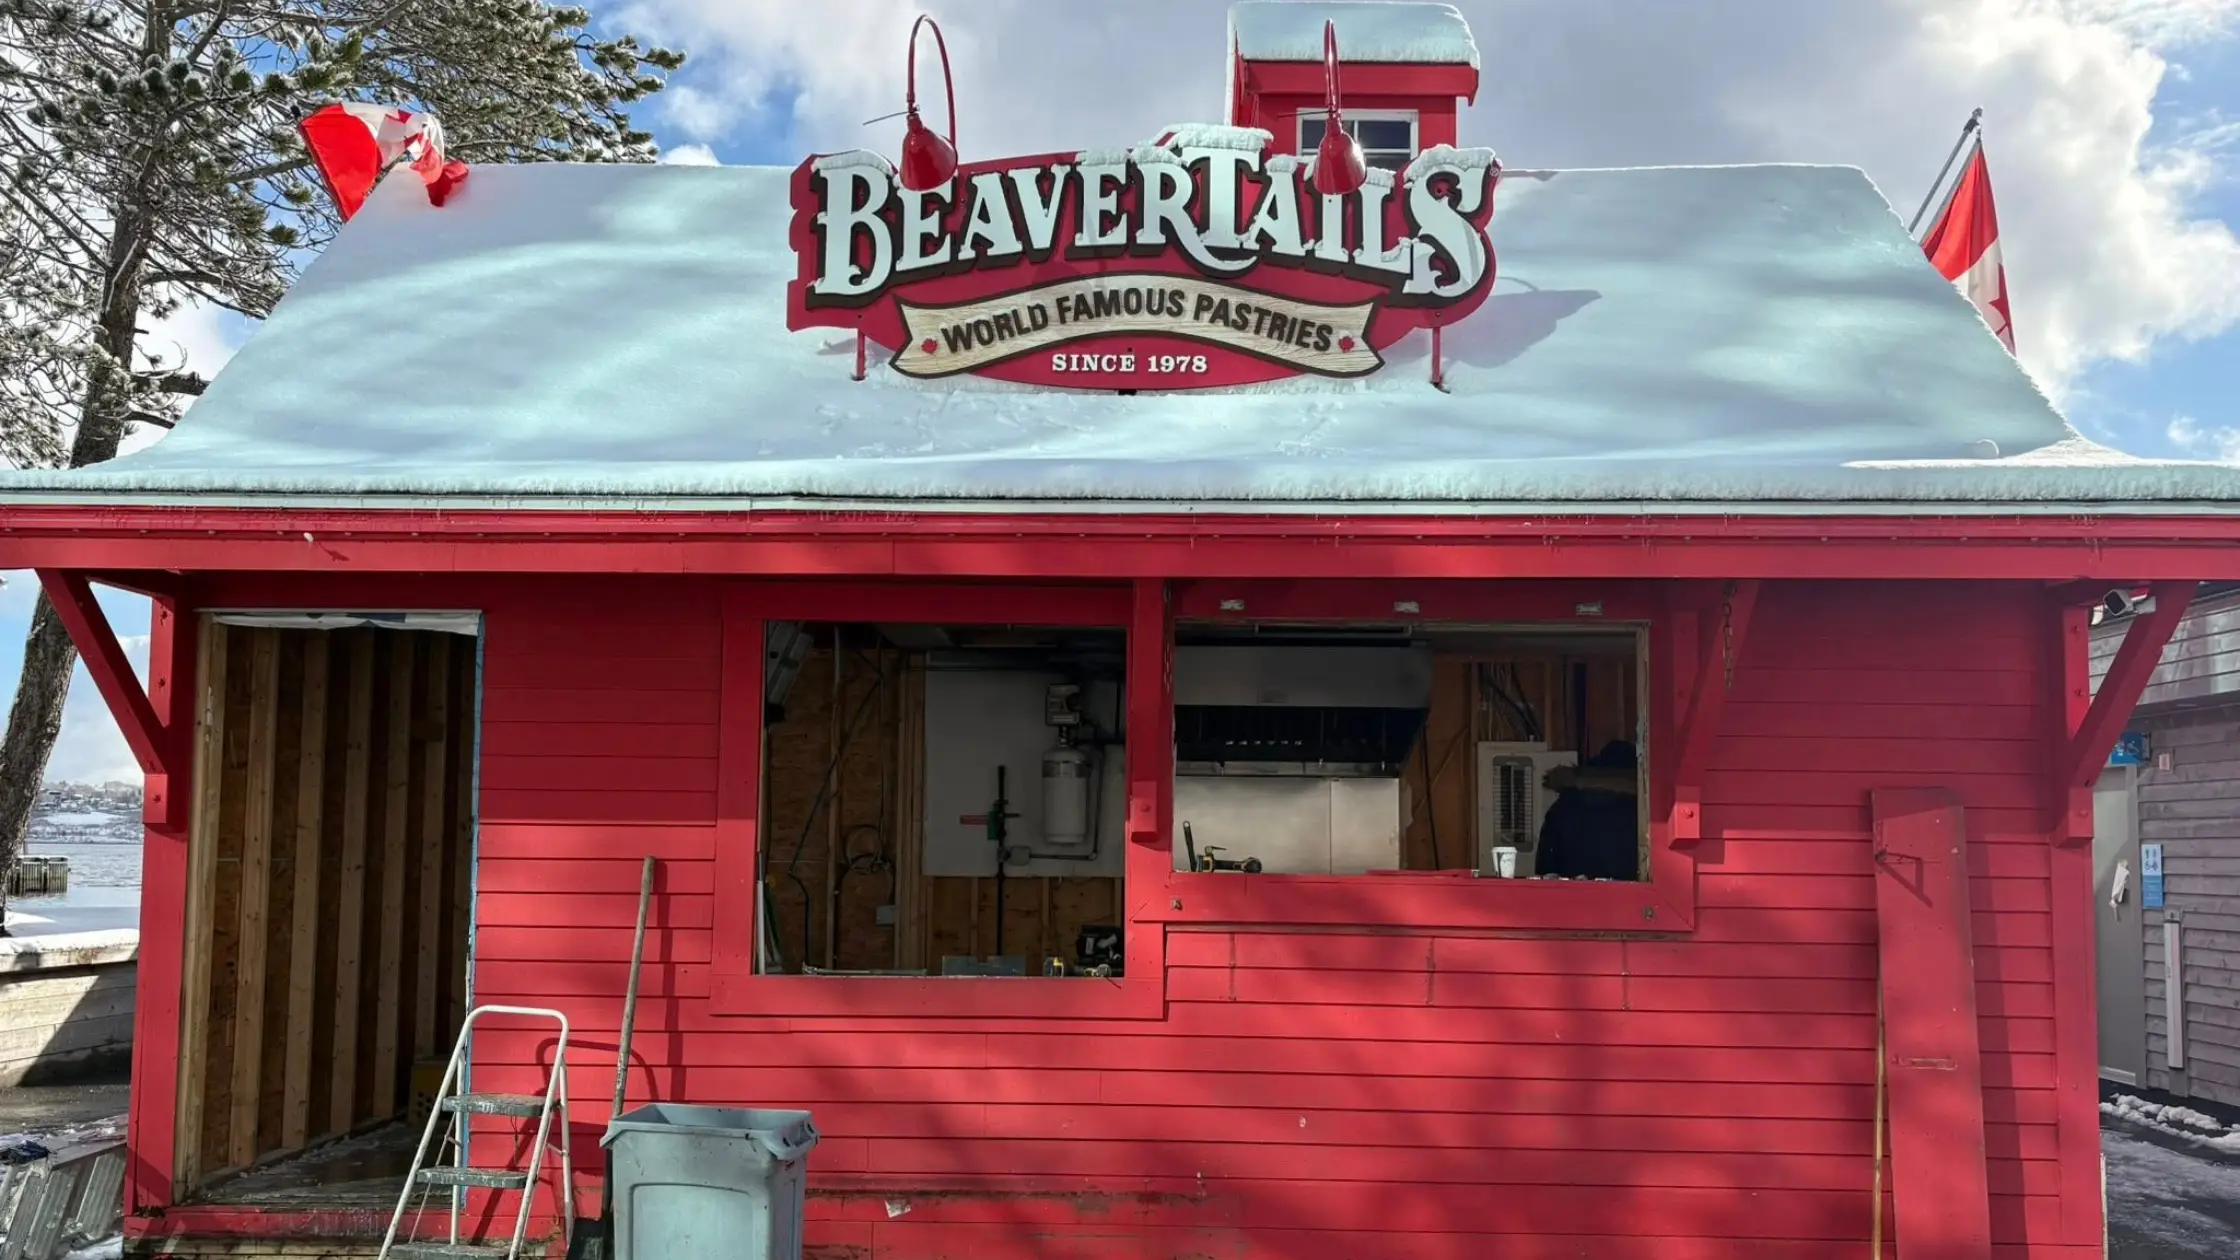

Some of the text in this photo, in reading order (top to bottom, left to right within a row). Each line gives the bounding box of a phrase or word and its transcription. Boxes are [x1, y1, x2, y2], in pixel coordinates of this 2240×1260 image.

[813, 146, 1487, 298] BEAVERTAILS
[941, 287, 1333, 354] WORLD FAMOUS PASTRIES
[1052, 354, 1207, 373] SINCE 1978
